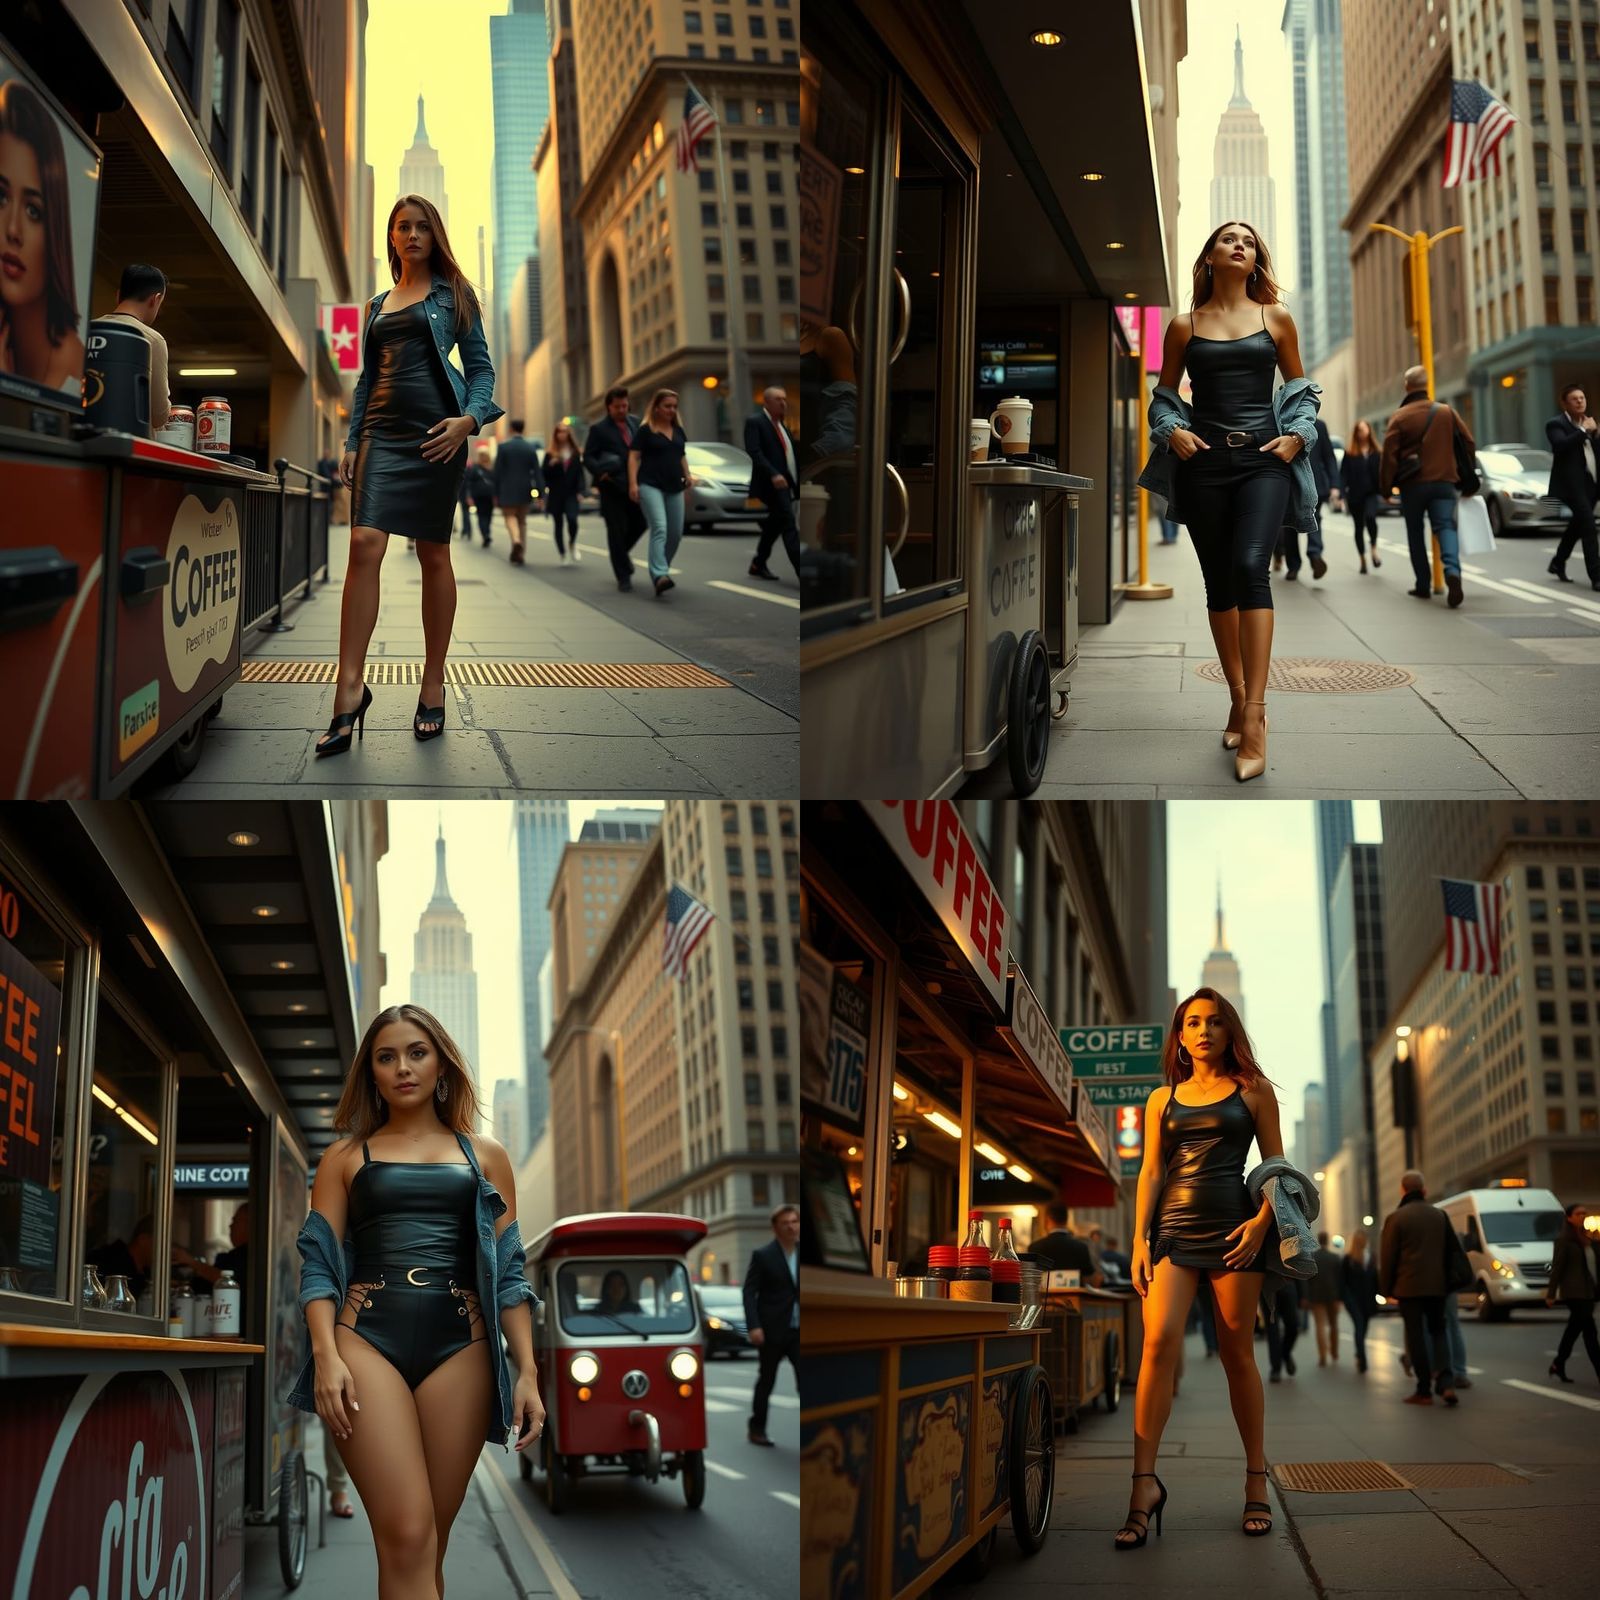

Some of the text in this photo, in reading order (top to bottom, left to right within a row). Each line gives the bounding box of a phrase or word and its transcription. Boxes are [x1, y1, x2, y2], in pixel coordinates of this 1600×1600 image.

[171, 544, 237, 628] COFFEE
[882, 800, 1005, 983] OFFEE
[1016, 985, 1069, 1099] COFFEE
